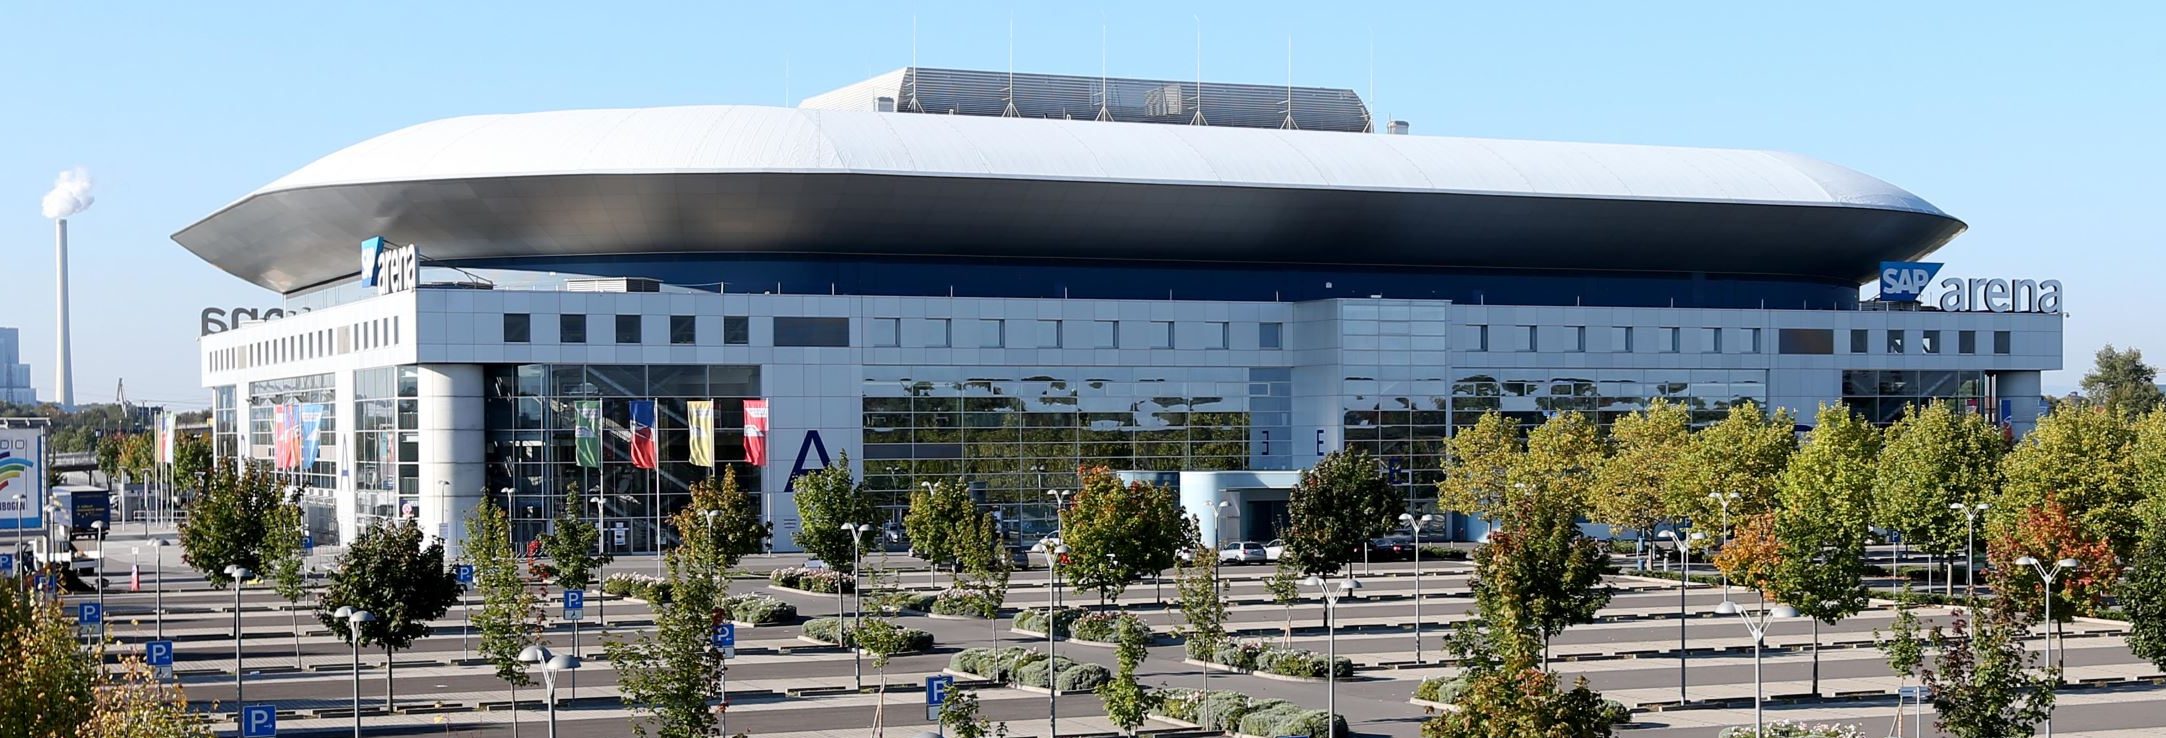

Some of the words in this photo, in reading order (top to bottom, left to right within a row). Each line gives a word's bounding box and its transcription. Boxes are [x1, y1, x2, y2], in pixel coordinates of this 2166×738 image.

[377, 243, 416, 296] arena
[1882, 267, 1929, 295] SAP
[1940, 277, 2064, 314] arena
[1316, 429, 1325, 457] E
[783, 429, 832, 493] A
[1892, 530, 1899, 541] P
[0, 555, 9, 568] P
[460, 567, 470, 580] P
[568, 592, 579, 607] P
[83, 605, 96, 621] P
[152, 644, 167, 664] P
[251, 709, 268, 733] P
